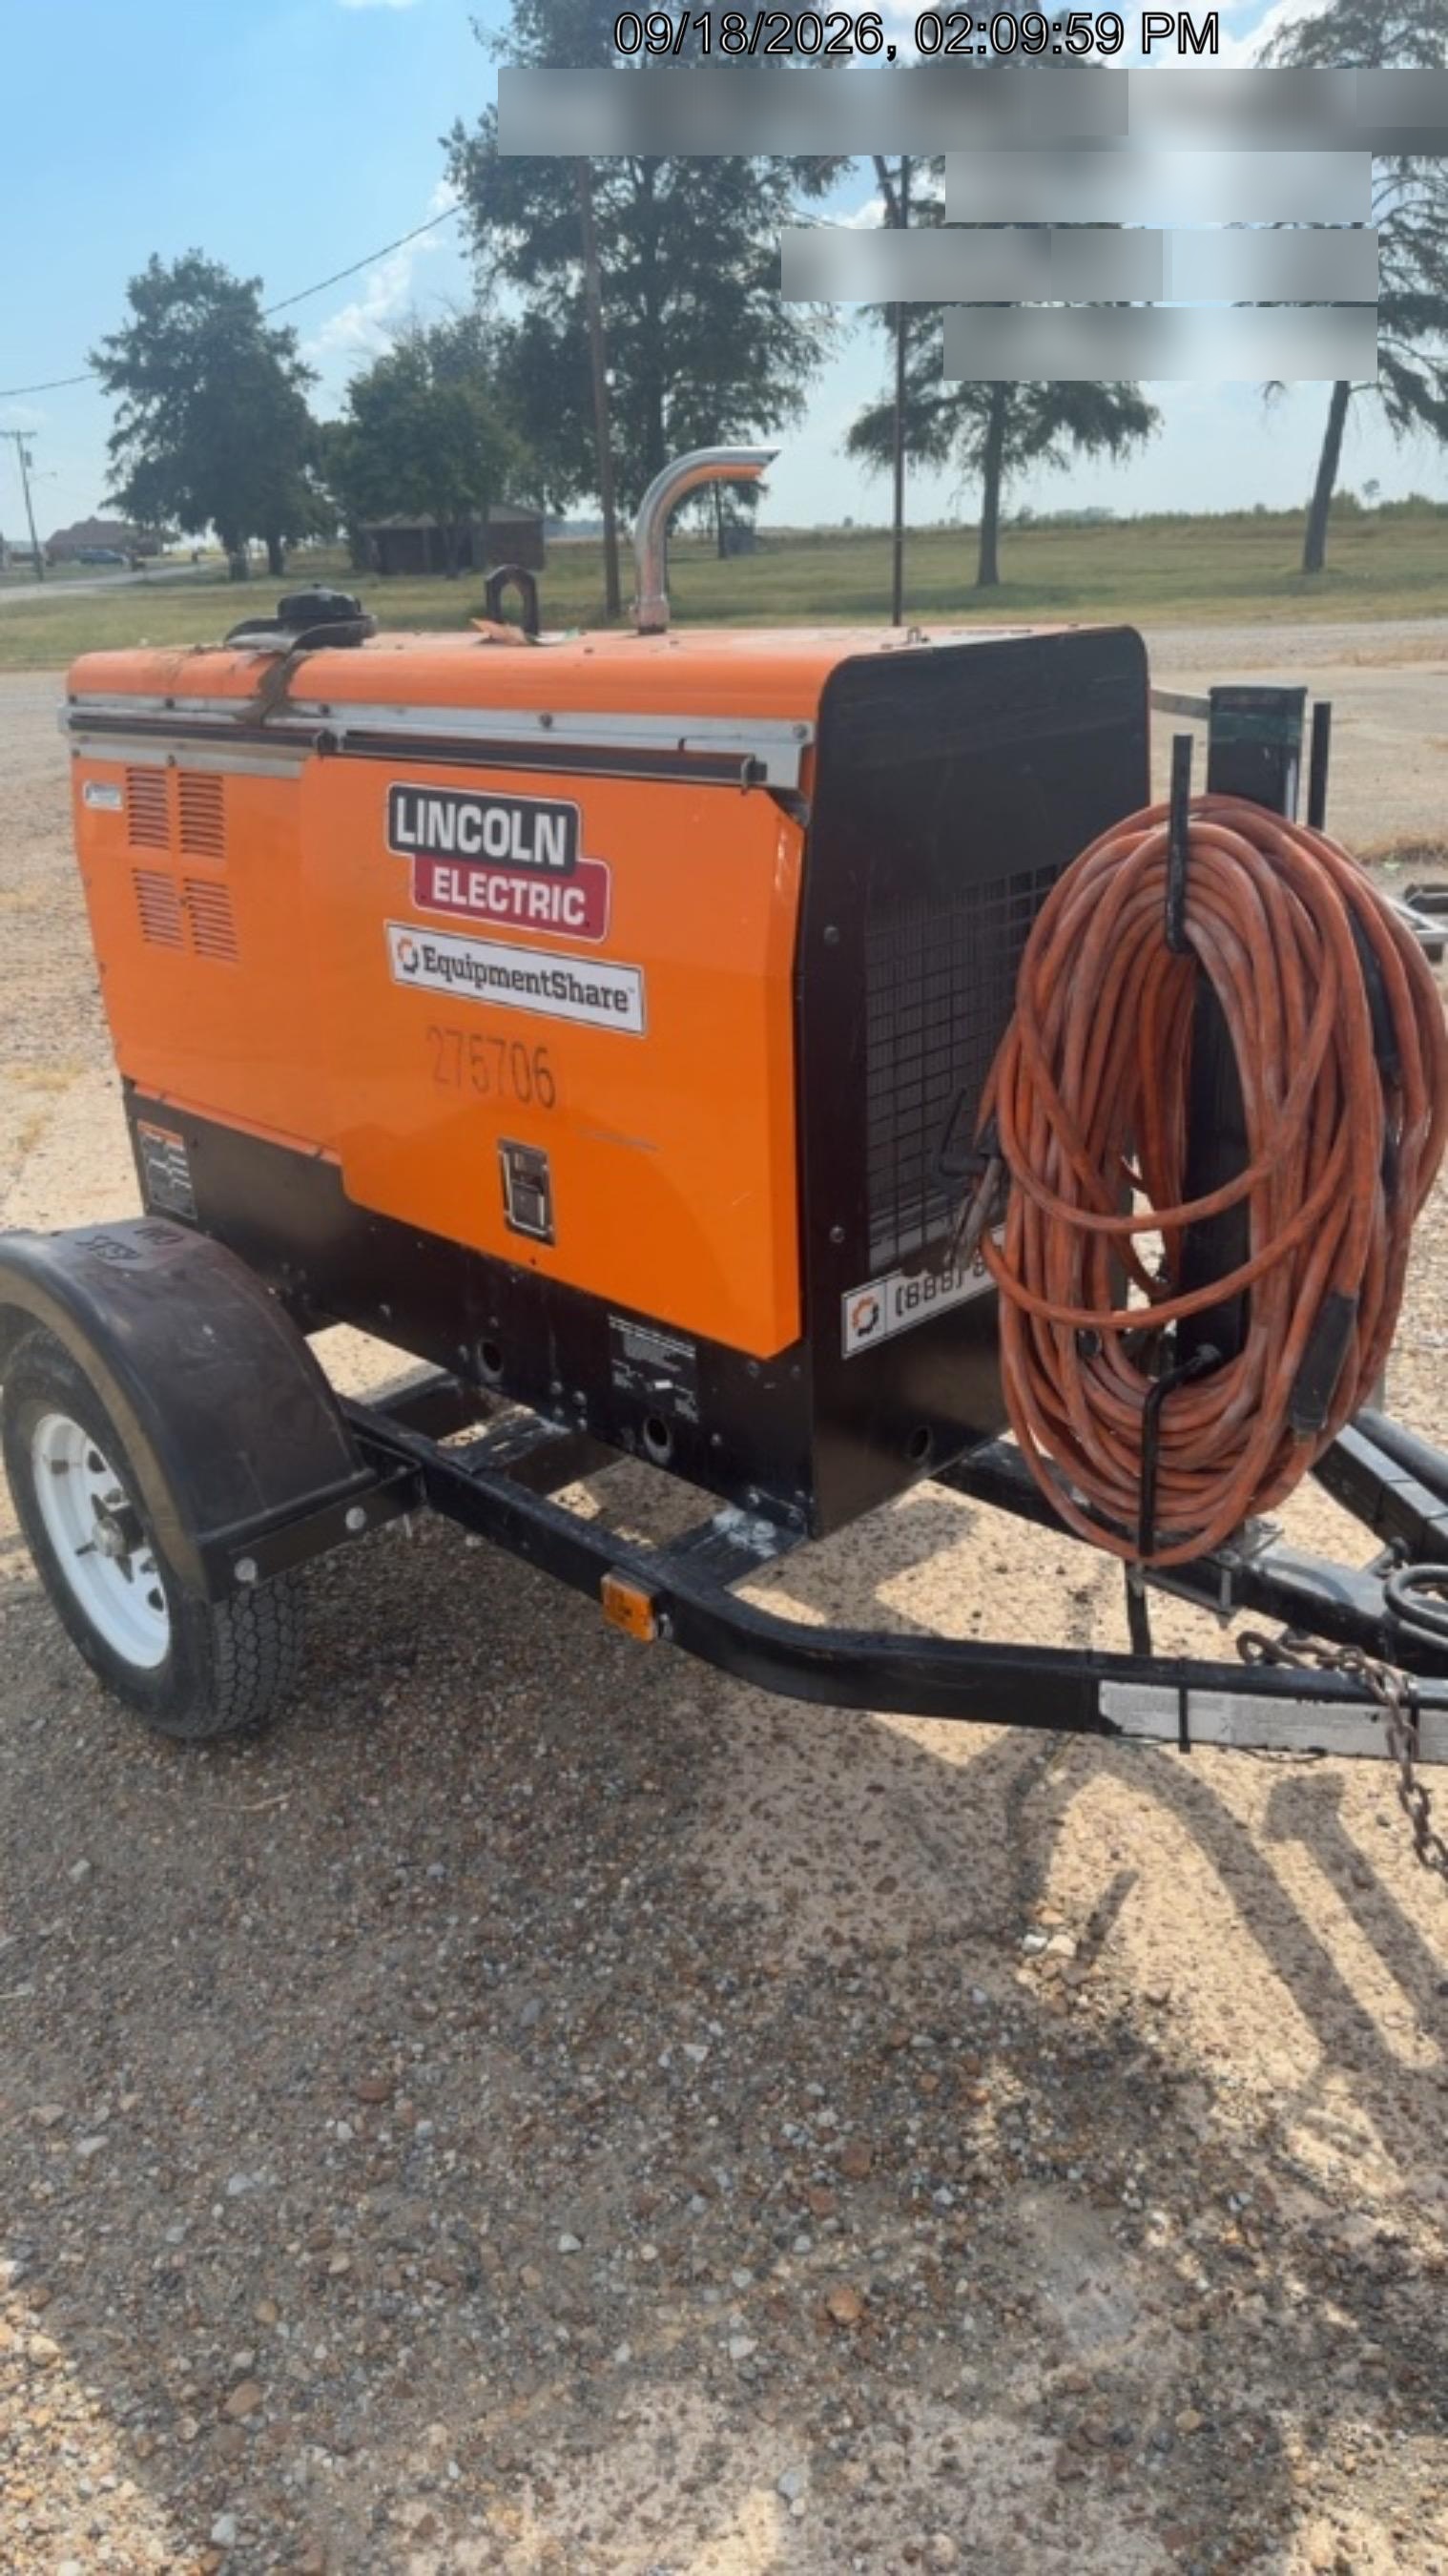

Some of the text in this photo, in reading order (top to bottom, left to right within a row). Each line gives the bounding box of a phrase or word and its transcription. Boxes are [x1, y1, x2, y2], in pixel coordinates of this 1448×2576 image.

[396, 796, 568, 866] LINCOLN
[432, 865, 586, 926] ELECTRIC
[423, 945, 631, 1013] EquipmentShare
[427, 1024, 556, 1110] 275706
